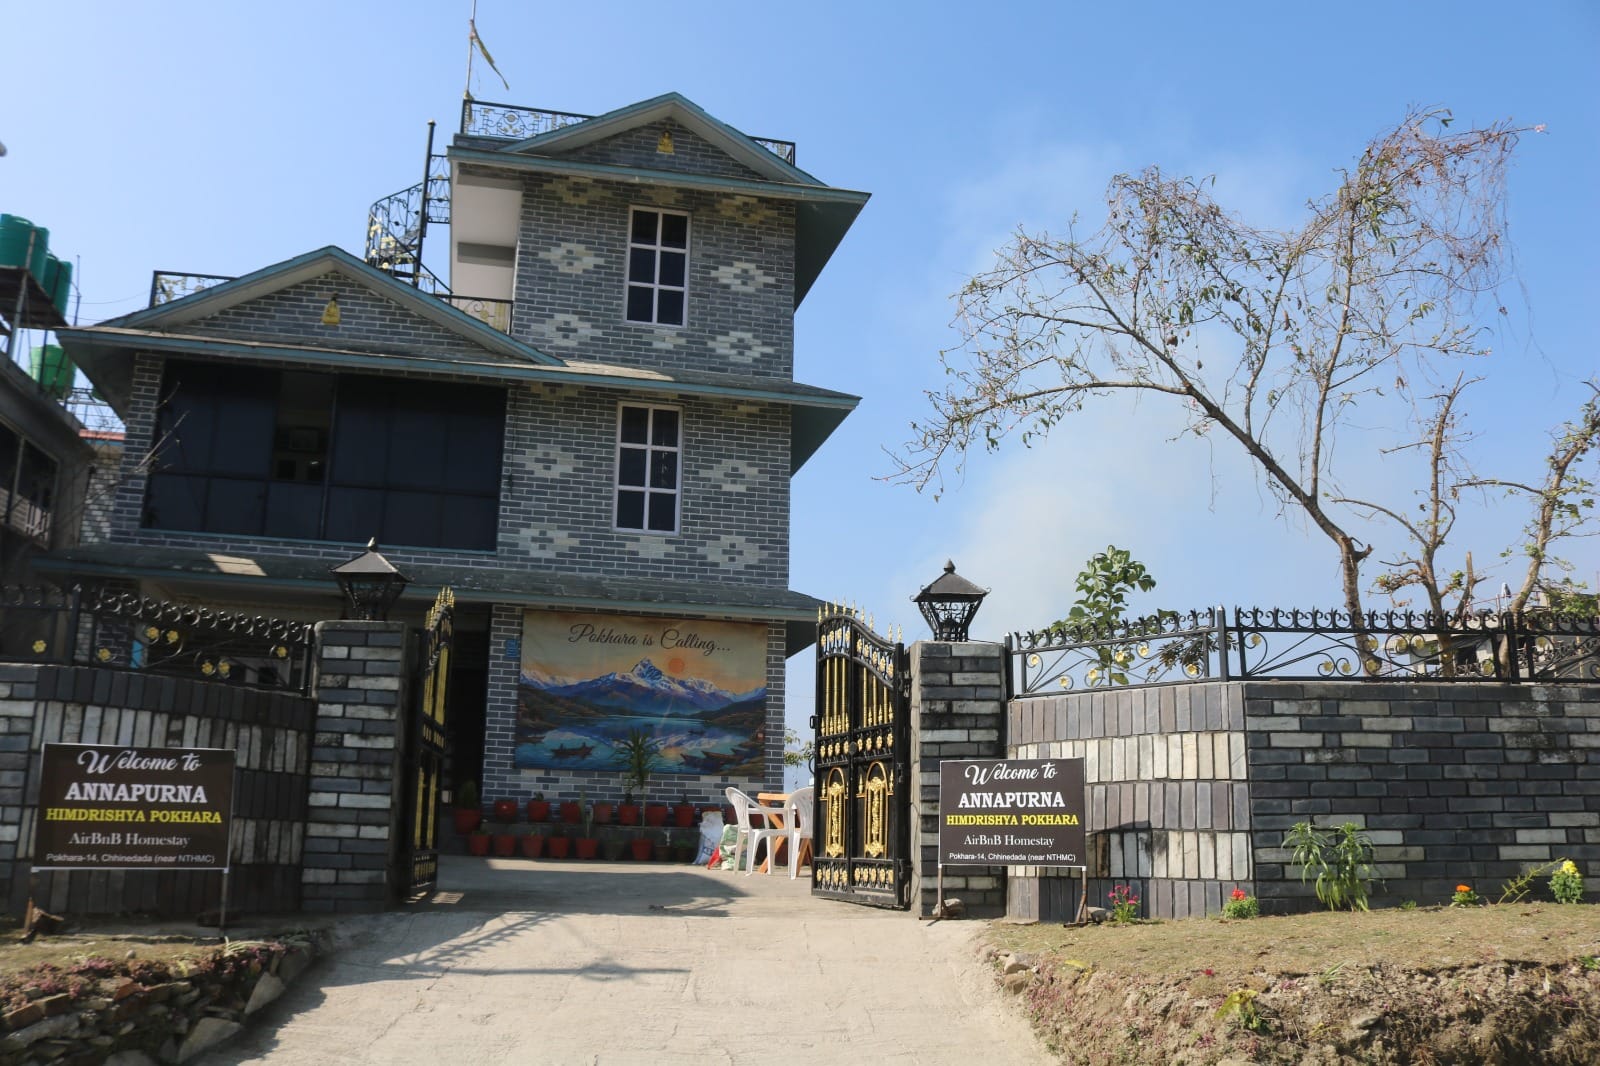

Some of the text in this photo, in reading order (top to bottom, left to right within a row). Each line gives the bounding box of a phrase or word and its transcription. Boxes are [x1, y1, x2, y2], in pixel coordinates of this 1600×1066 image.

[568, 623, 638, 644] Pokhara
[642, 632, 653, 646] is
[77, 750, 202, 774] Welcome to
[964, 762, 1058, 785] Welcome to
[64, 782, 208, 803] ANNAPURNA
[958, 791, 1066, 808] ANNAPURNA
[46, 808, 222, 824] HIMDRISHYA POKHARA
[946, 814, 1079, 826] HIMDRISHYA POKHARA
[68, 832, 190, 848] AirBnB Homestay
[964, 834, 1055, 848] AirBnB Homestay
[154, 854, 177, 864] (near
[178, 854, 216, 864] NTHMC)
[1027, 853, 1045, 862] (near
[1045, 853, 1076, 862] NTHMC)
